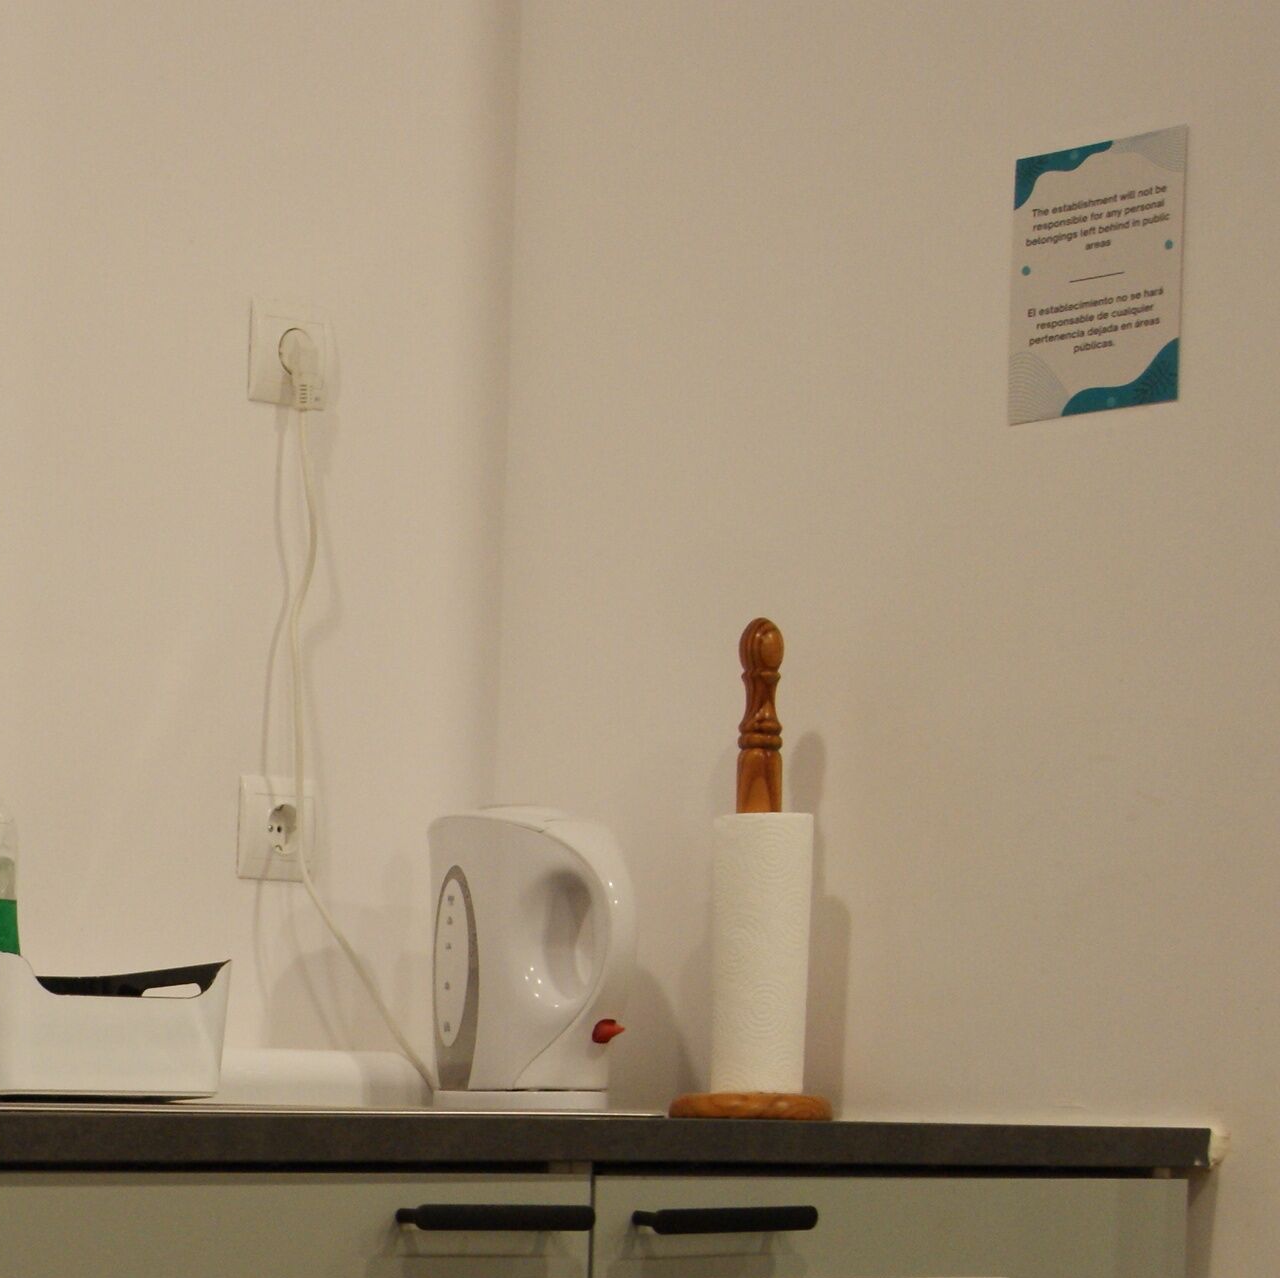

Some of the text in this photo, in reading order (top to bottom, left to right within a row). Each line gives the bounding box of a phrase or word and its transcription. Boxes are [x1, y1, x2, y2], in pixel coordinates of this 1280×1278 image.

[1032, 184, 1168, 218] The establishment will not be
[1032, 198, 1165, 232] responsible for any personal
[1025, 212, 1171, 247] belongings left behind in public
[1085, 238, 1112, 251] areas
[1027, 308, 1036, 318] El
[1038, 296, 1114, 317] establecimiento
[1115, 294, 1128, 303] no
[1130, 291, 1142, 300] se
[1036, 303, 1154, 330] responsable de cualquier
[1028, 329, 1085, 347] pertenencia
[1087, 324, 1119, 337] dejada
[1120, 321, 1133, 330] en
